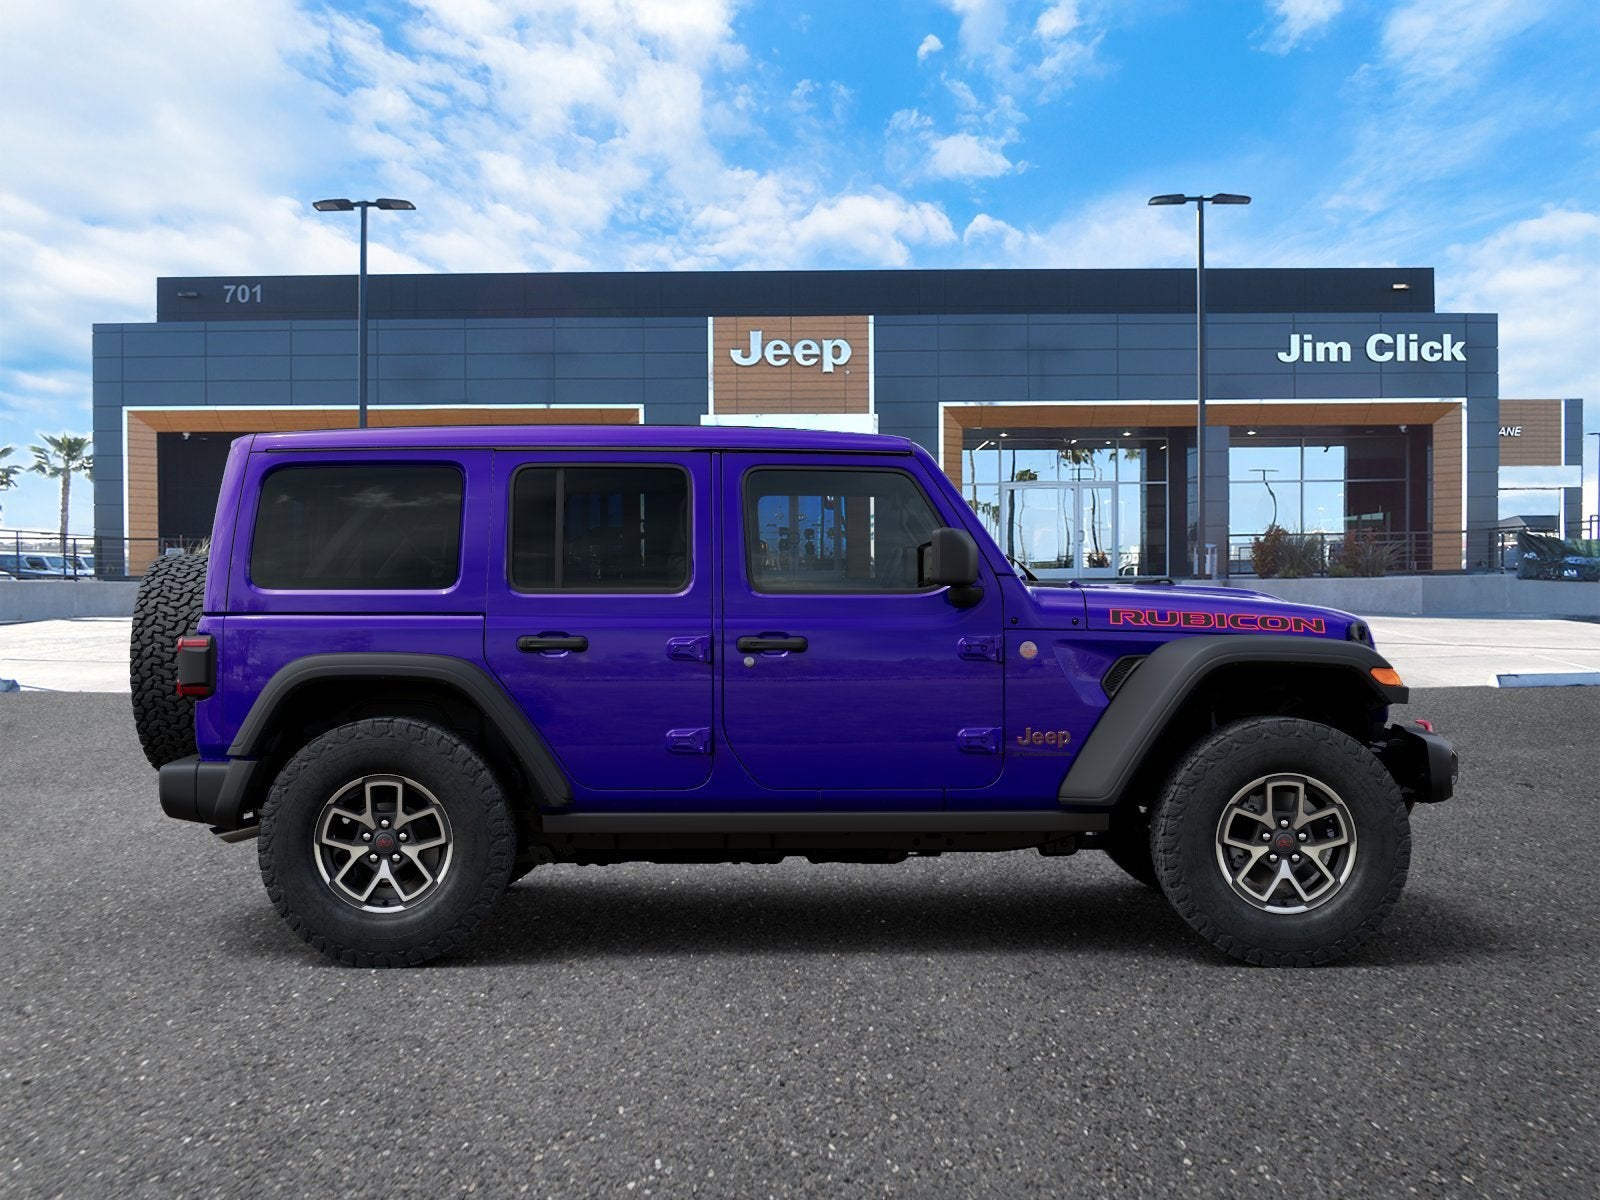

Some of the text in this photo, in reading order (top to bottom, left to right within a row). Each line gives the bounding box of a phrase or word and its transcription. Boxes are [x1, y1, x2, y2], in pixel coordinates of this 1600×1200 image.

[223, 284, 262, 304] 701
[729, 329, 852, 374] Jeep
[1277, 333, 1467, 363] Jim Click
[1109, 608, 1326, 634] RUBICON
[1016, 727, 1071, 749] Jeep
